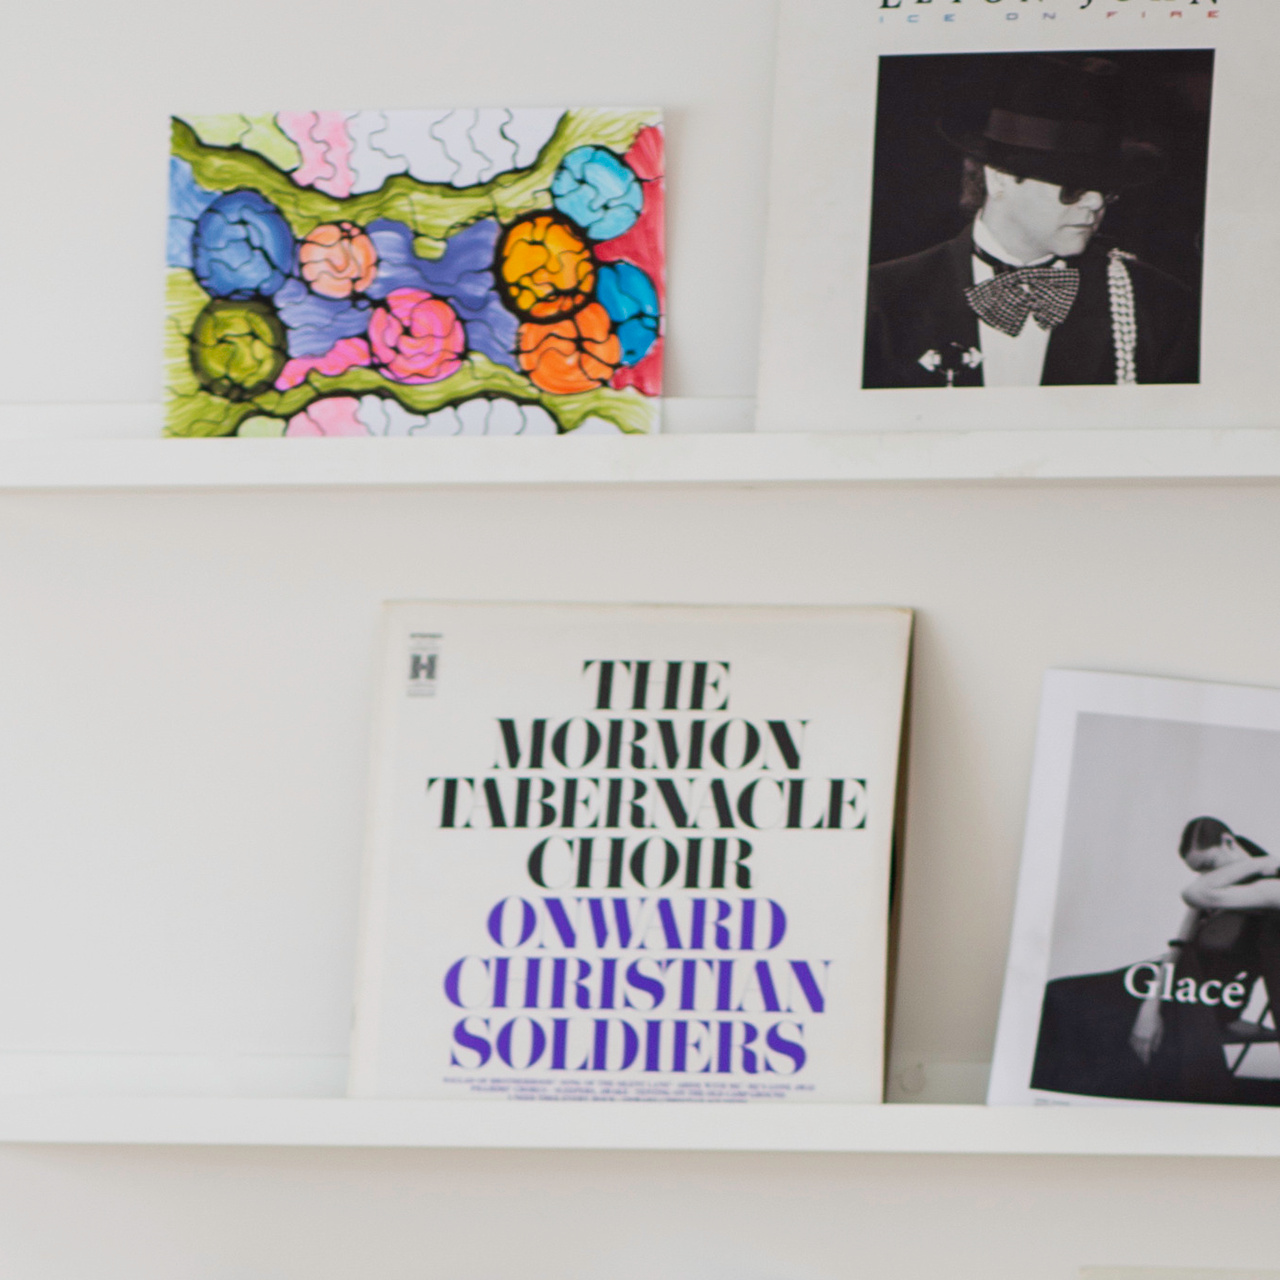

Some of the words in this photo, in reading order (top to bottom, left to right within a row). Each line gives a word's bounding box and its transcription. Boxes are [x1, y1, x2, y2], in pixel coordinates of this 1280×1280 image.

[878, 13, 956, 24] ICE
[1005, 11, 1057, 22] ON
[1105, 9, 1219, 20] FIRE
[582, 659, 731, 711] THE
[490, 718, 810, 771] MORMON
[426, 777, 868, 830] TABERNACLE
[527, 836, 754, 890] CHOIR
[486, 896, 788, 951] ONWARD
[442, 957, 833, 1014] CHRISTIAN
[1123, 962, 1247, 1009] Glacé
[449, 1017, 807, 1075] SOLDIERS
